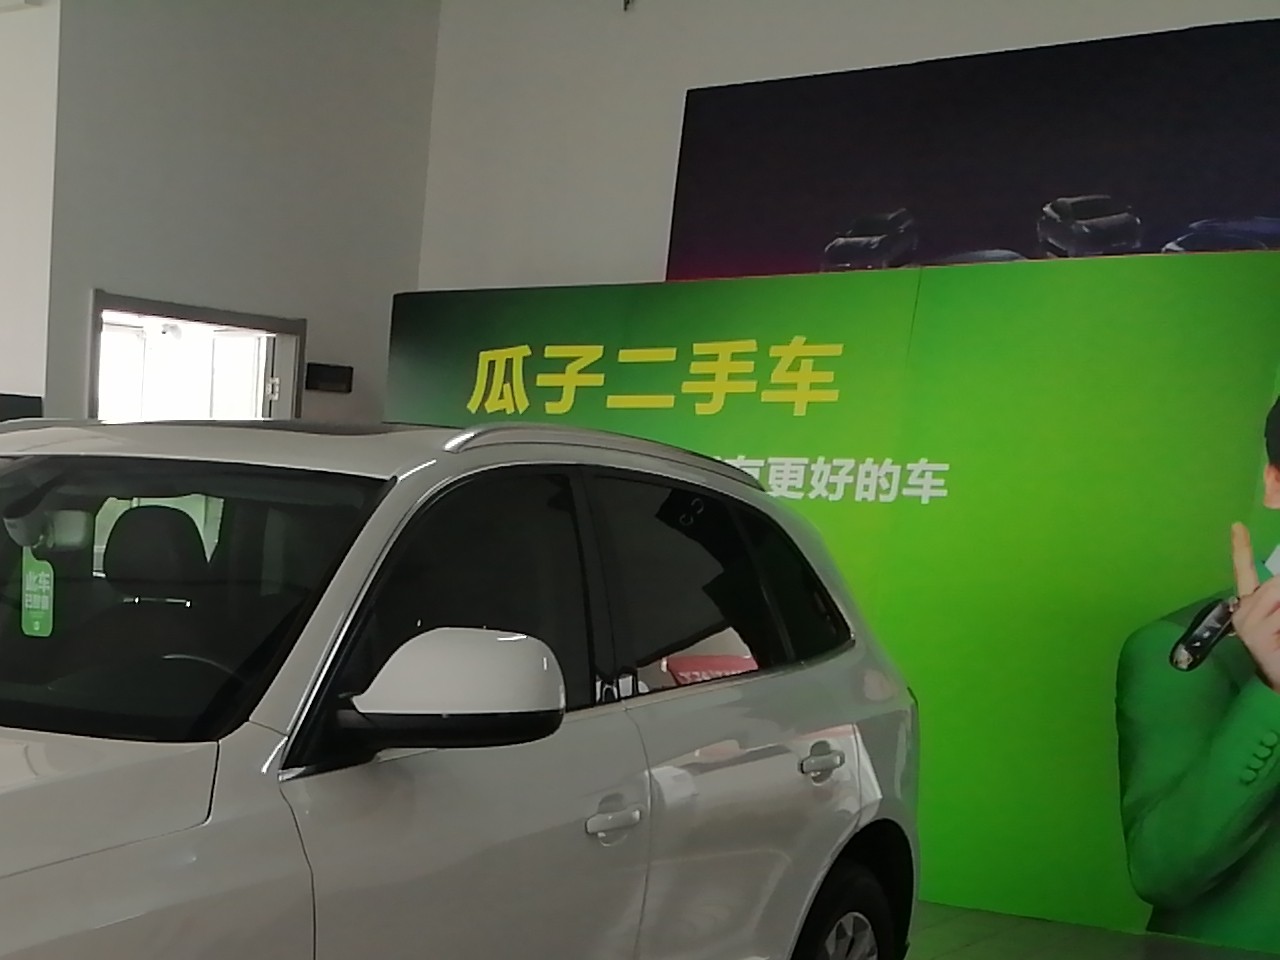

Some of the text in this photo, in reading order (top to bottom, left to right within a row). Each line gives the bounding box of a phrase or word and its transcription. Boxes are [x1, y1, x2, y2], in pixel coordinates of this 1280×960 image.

[466, 336, 844, 416] 瓜子二手车
